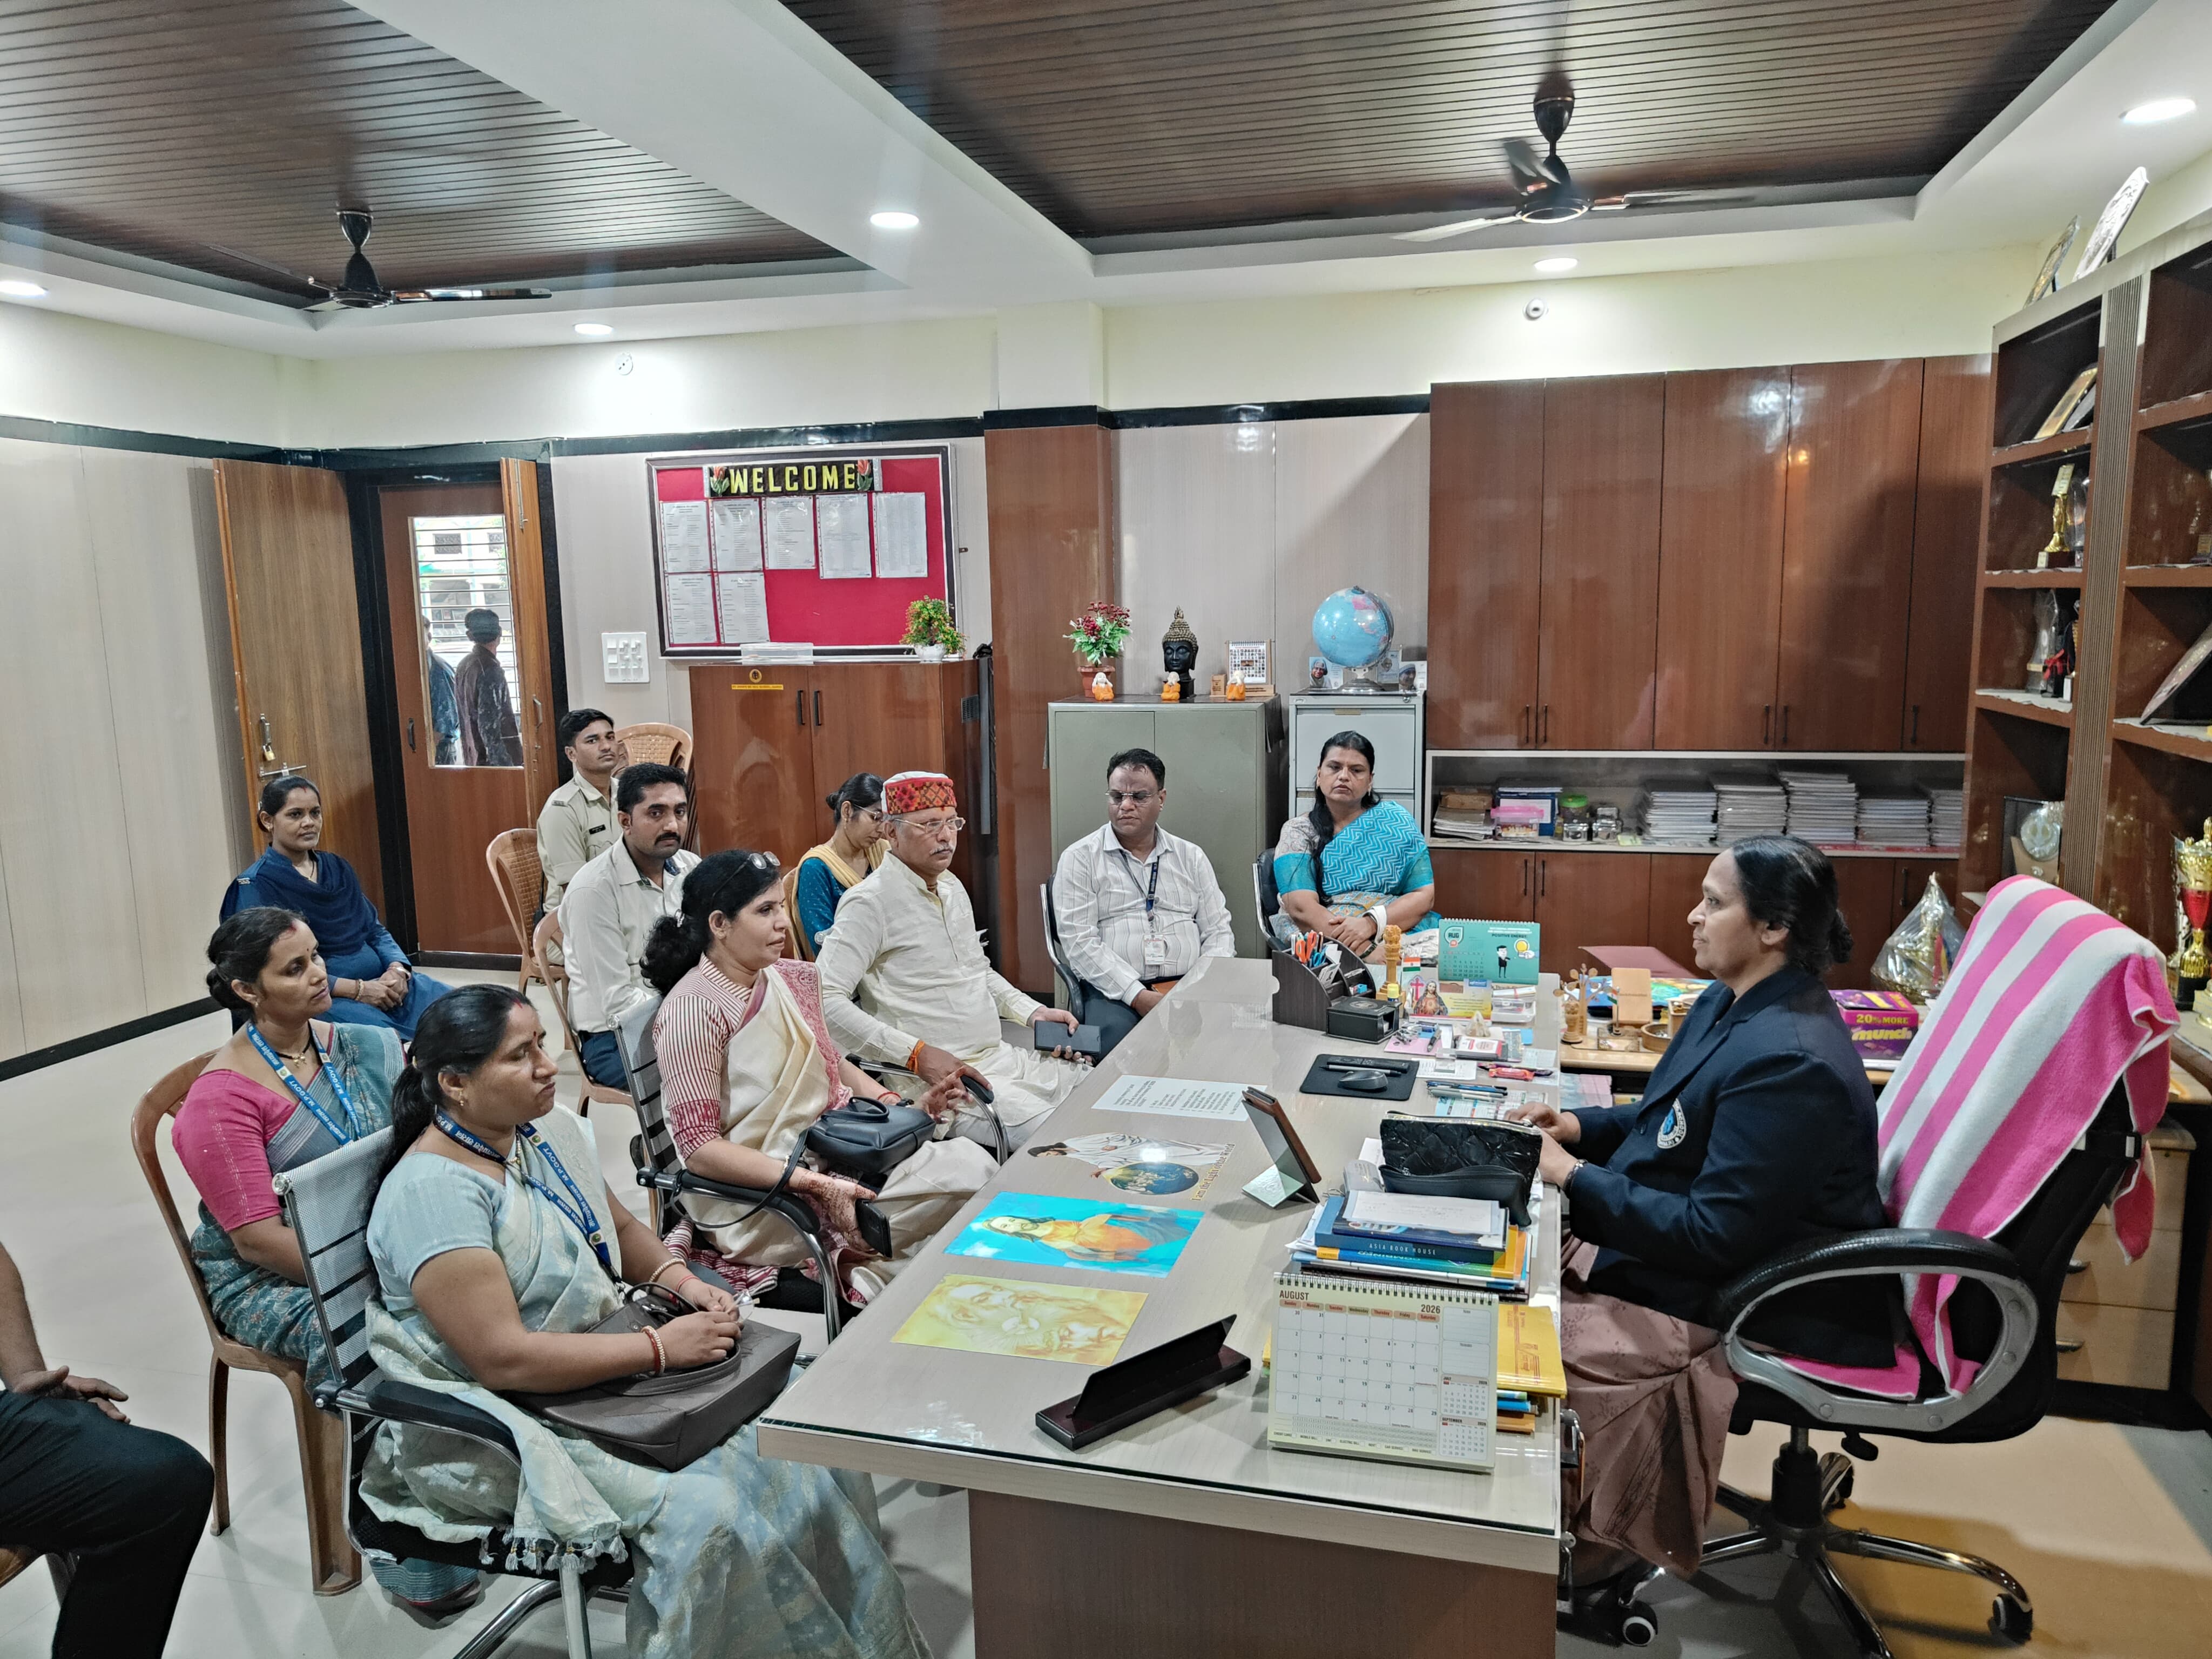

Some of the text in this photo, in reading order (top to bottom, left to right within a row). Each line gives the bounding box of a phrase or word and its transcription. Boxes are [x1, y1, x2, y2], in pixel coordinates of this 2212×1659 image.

[730, 463, 855, 494] WELCOME
[1856, 1014, 1880, 1024] 20%
[1852, 1028, 1912, 1041] munch
[542, 1147, 569, 1182] M.P.GOVT
[1390, 1245, 1408, 1253] BOOK
[1413, 1247, 1437, 1256] HOUSE
[1279, 1290, 1310, 1300] AUGUST
[1421, 1304, 1441, 1314] 2026
